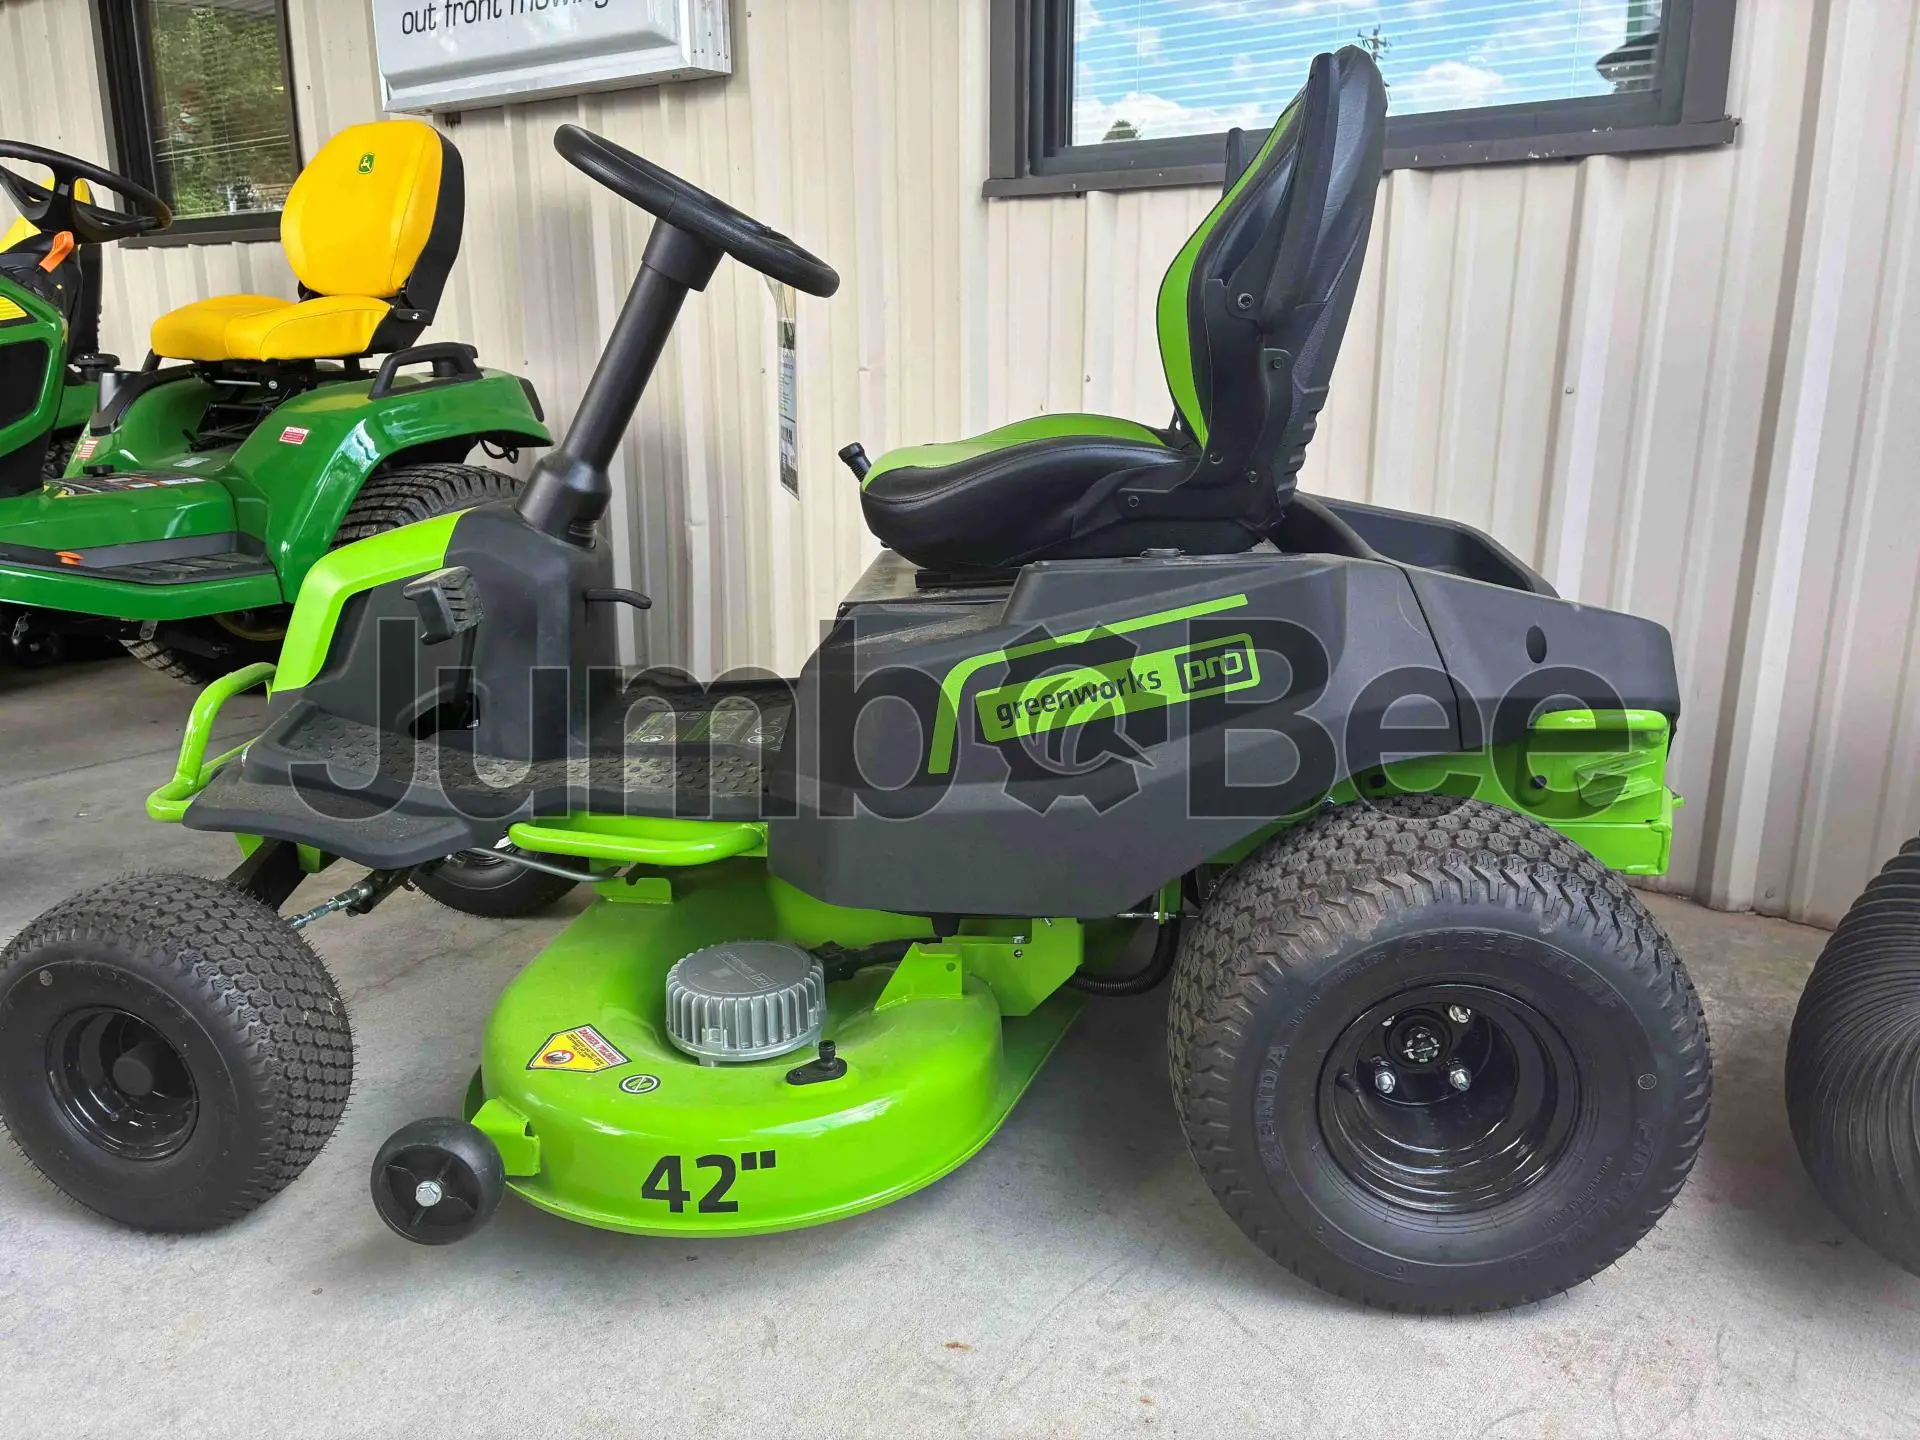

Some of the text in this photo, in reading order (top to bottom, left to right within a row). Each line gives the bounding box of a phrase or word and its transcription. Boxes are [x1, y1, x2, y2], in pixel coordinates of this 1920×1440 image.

[402, 3, 436, 34] out
[996, 652, 1244, 730] greenworks pro
[641, 1150, 776, 1213] 42"
